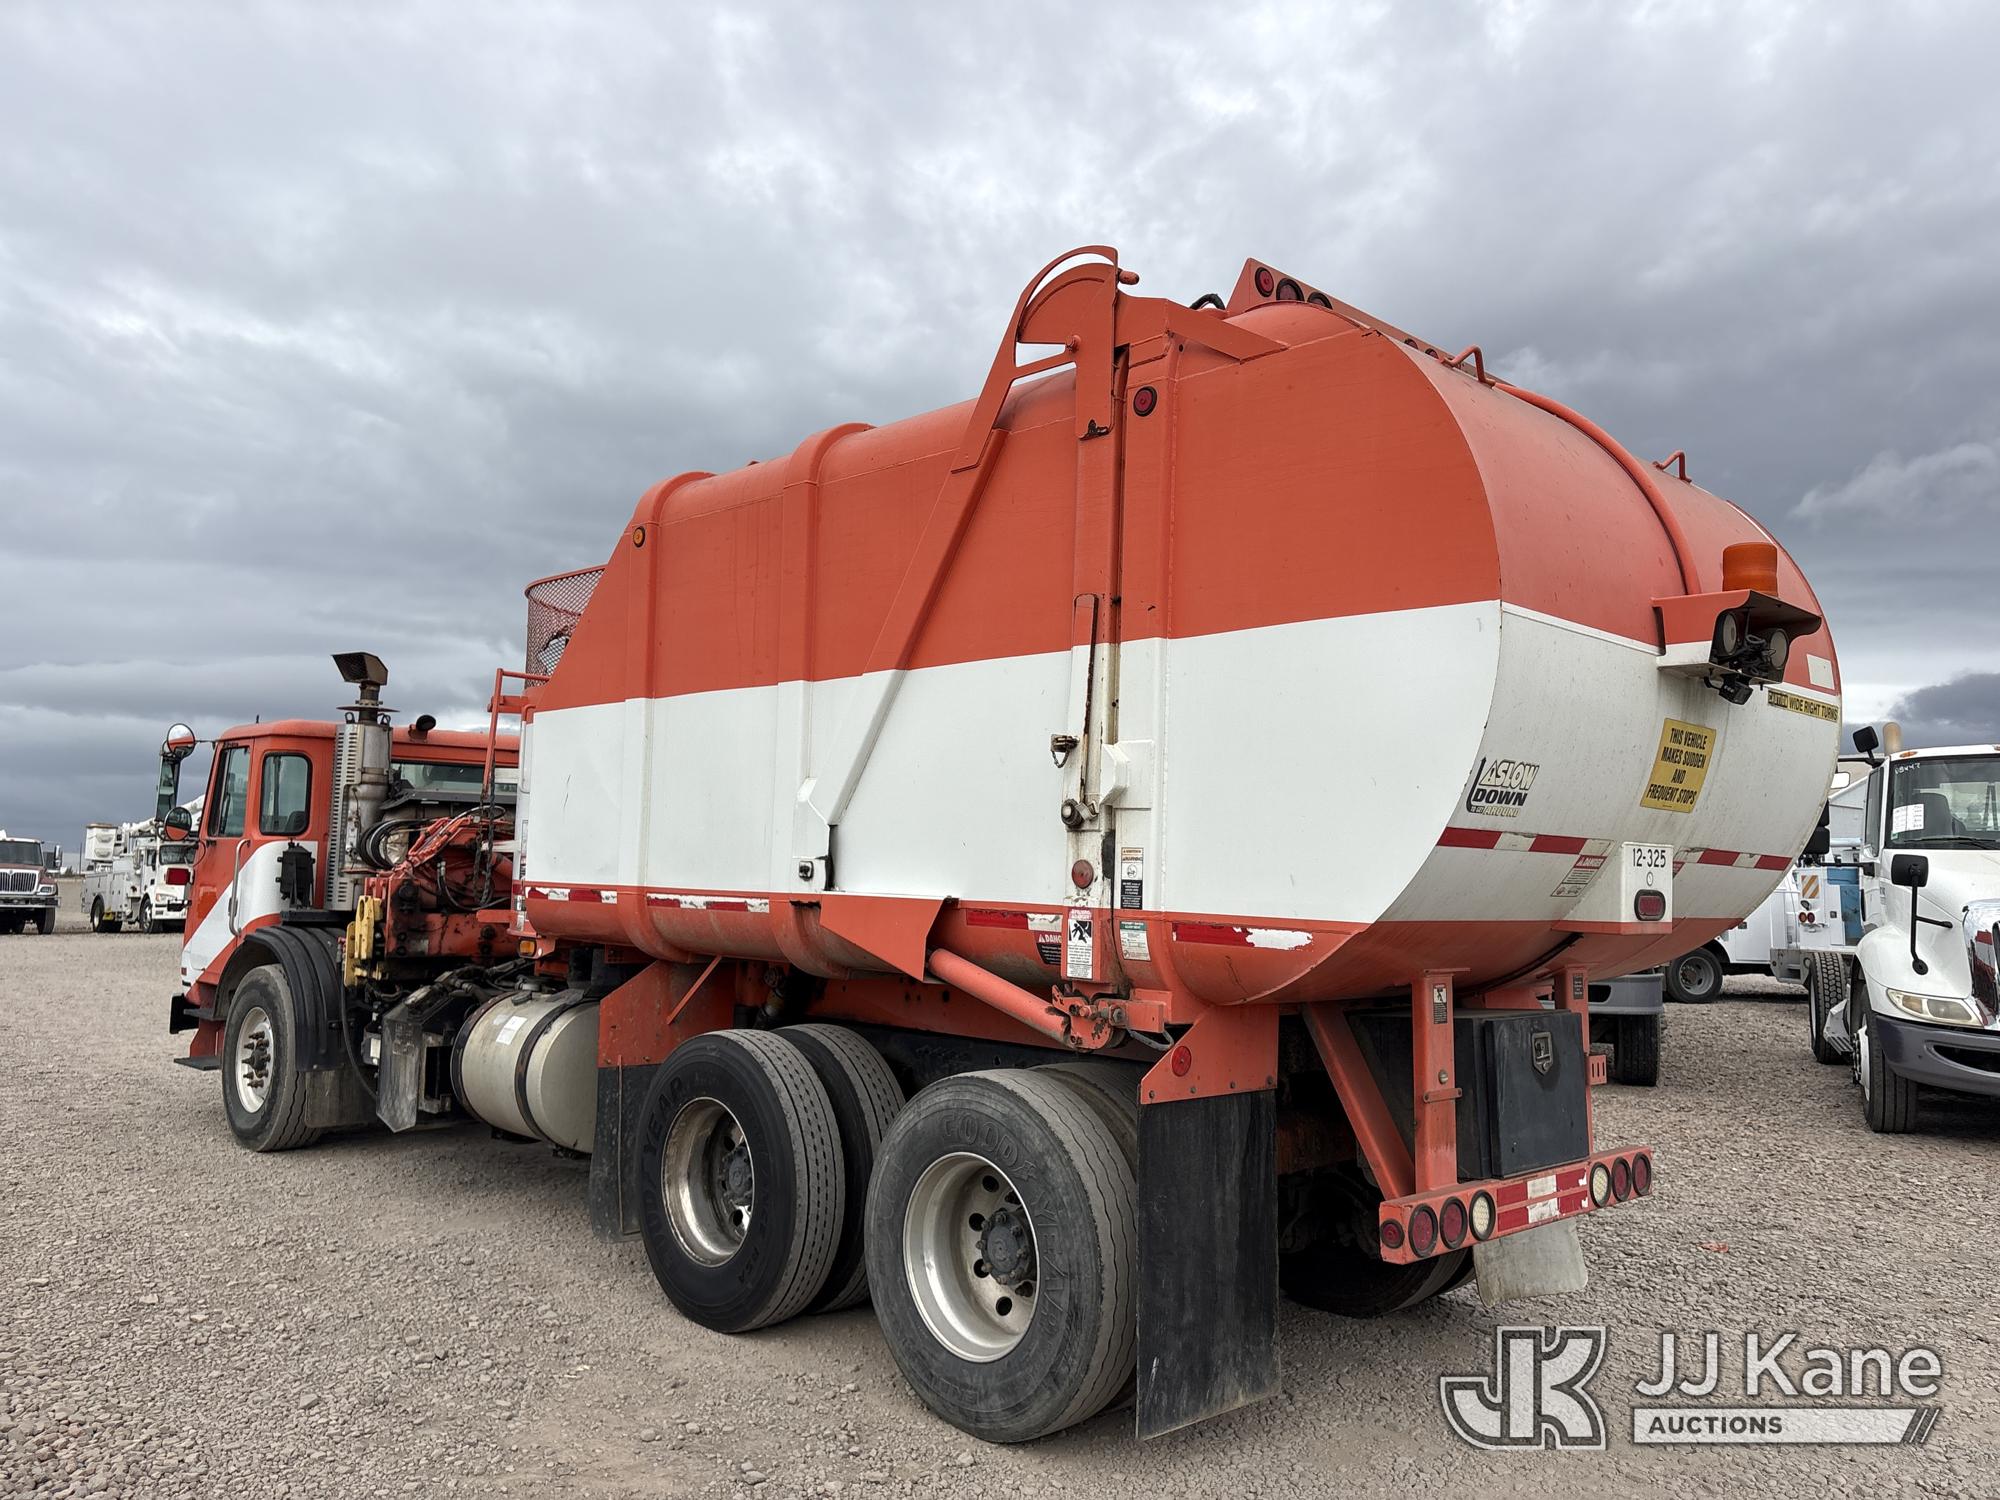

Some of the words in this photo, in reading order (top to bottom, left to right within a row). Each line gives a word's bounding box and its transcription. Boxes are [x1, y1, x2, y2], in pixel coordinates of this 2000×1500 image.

[1789, 697, 1803, 711] WIDE
[1804, 701, 1820, 716] RIGHT
[1822, 705, 1838, 720] TURNS
[1670, 728, 1684, 745] THIS
[1684, 731, 1708, 750] VEHICLE
[1661, 746, 1684, 765] MAKES
[1682, 751, 1707, 769] SUDDEN
[1496, 759, 1540, 790] SLOW
[1671, 768, 1687, 784] AND
[1472, 788, 1528, 806] DOWN
[1646, 784, 1680, 802] FREQUENT
[1676, 788, 1697, 805] STOPS
[1483, 805, 1521, 817] AROUND
[1632, 848, 1666, 868] 12-325
[1045, 933, 1062, 944] DANG
